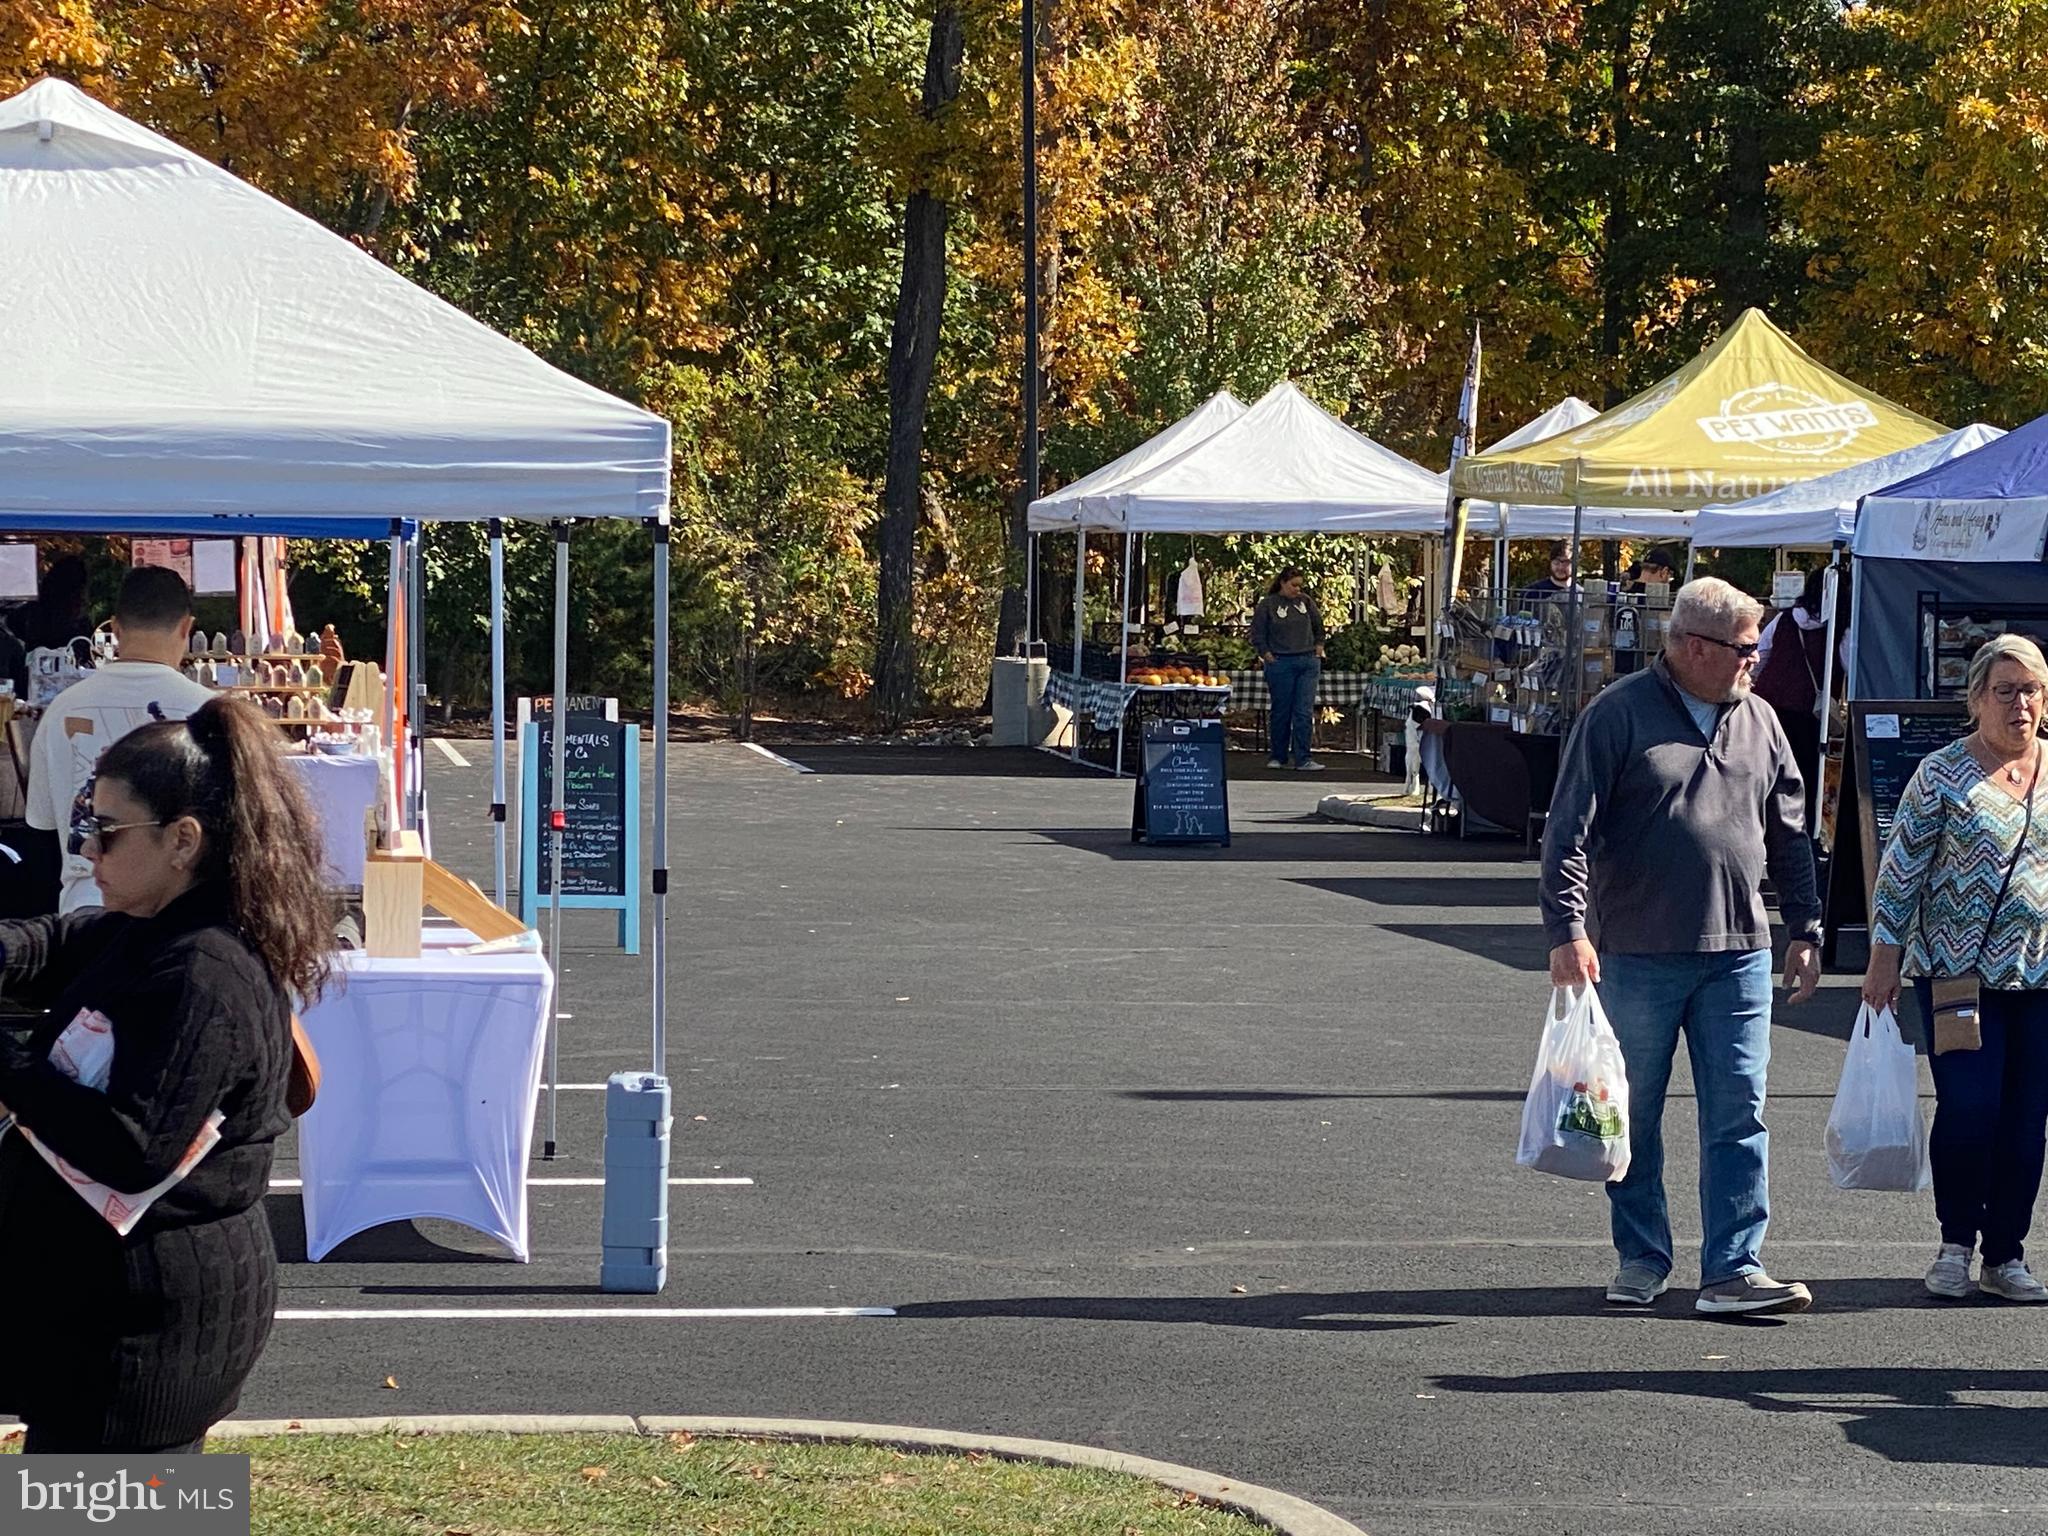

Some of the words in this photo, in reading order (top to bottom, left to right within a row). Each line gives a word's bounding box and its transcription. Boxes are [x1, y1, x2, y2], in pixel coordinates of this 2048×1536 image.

[1709, 418, 1763, 439] PET
[1765, 407, 1869, 433] WANTS
[1622, 466, 1673, 497] All
